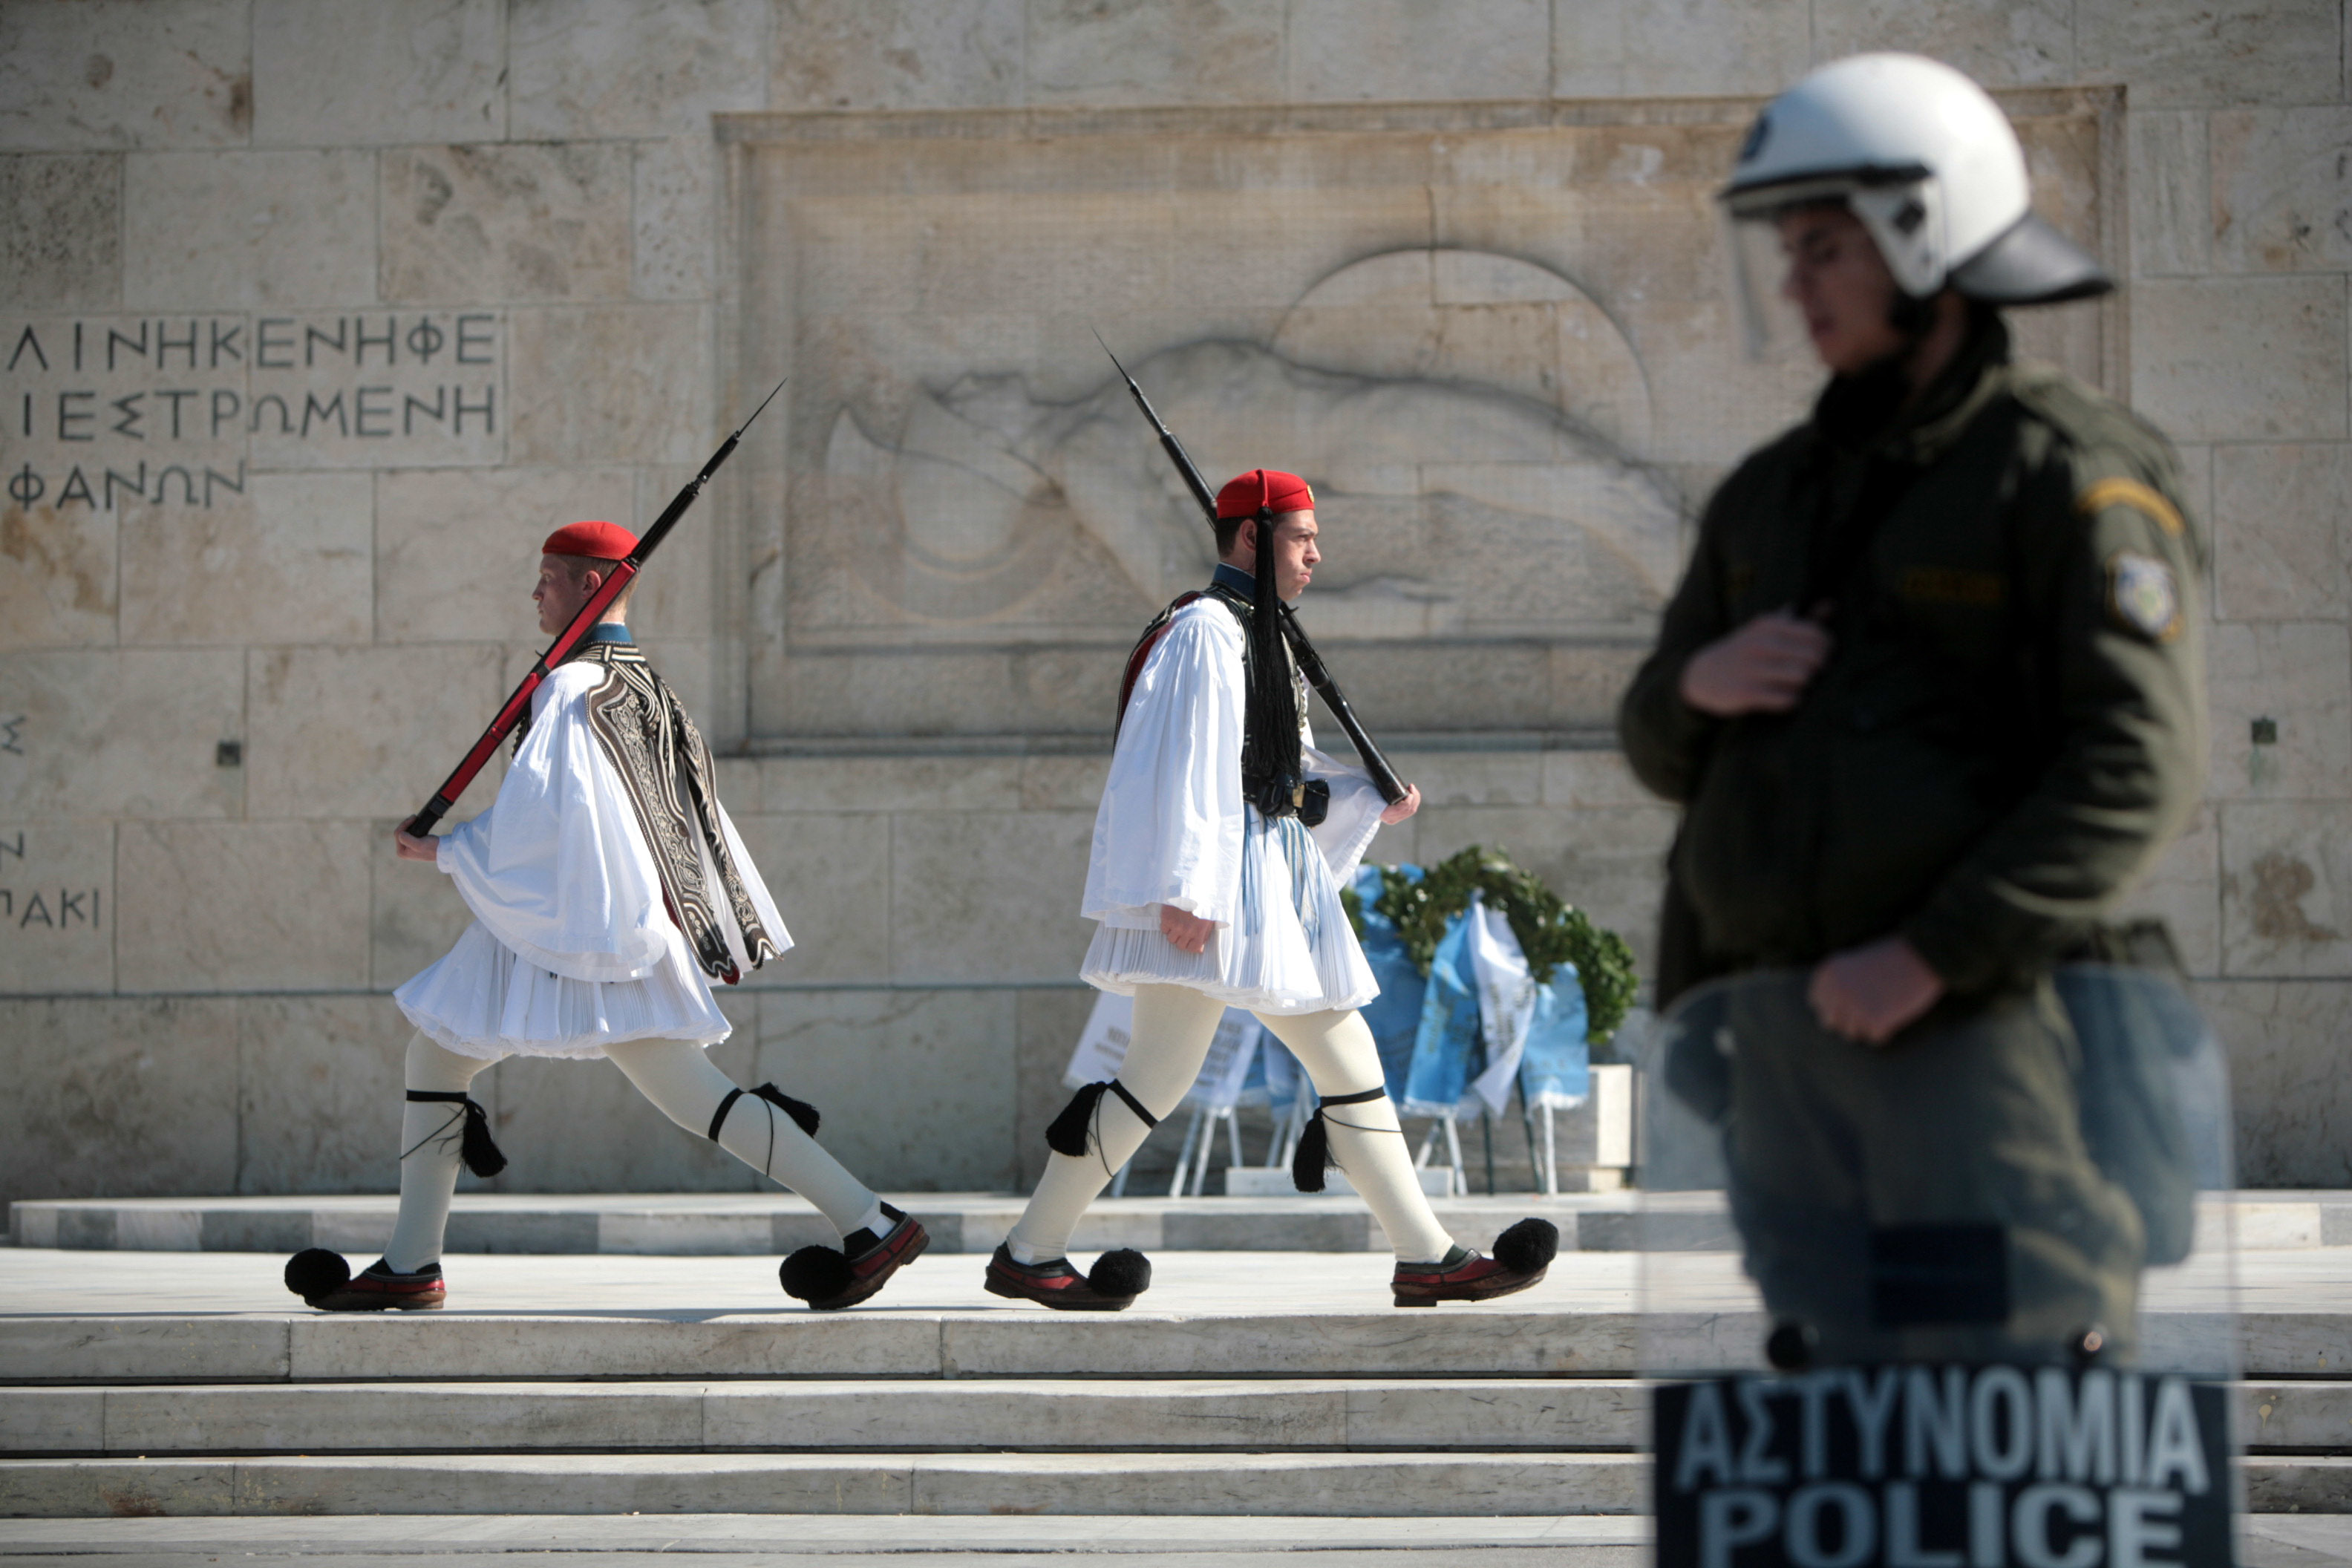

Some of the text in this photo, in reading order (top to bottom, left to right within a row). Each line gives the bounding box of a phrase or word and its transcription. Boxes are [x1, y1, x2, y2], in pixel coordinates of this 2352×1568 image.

[9, 461, 245, 510] ΦΑΝΩΝ
[1676, 1368, 2208, 1494] ΑΣΤΥΝΟΜΙΑ
[1699, 1485, 2184, 1568] POLICE
